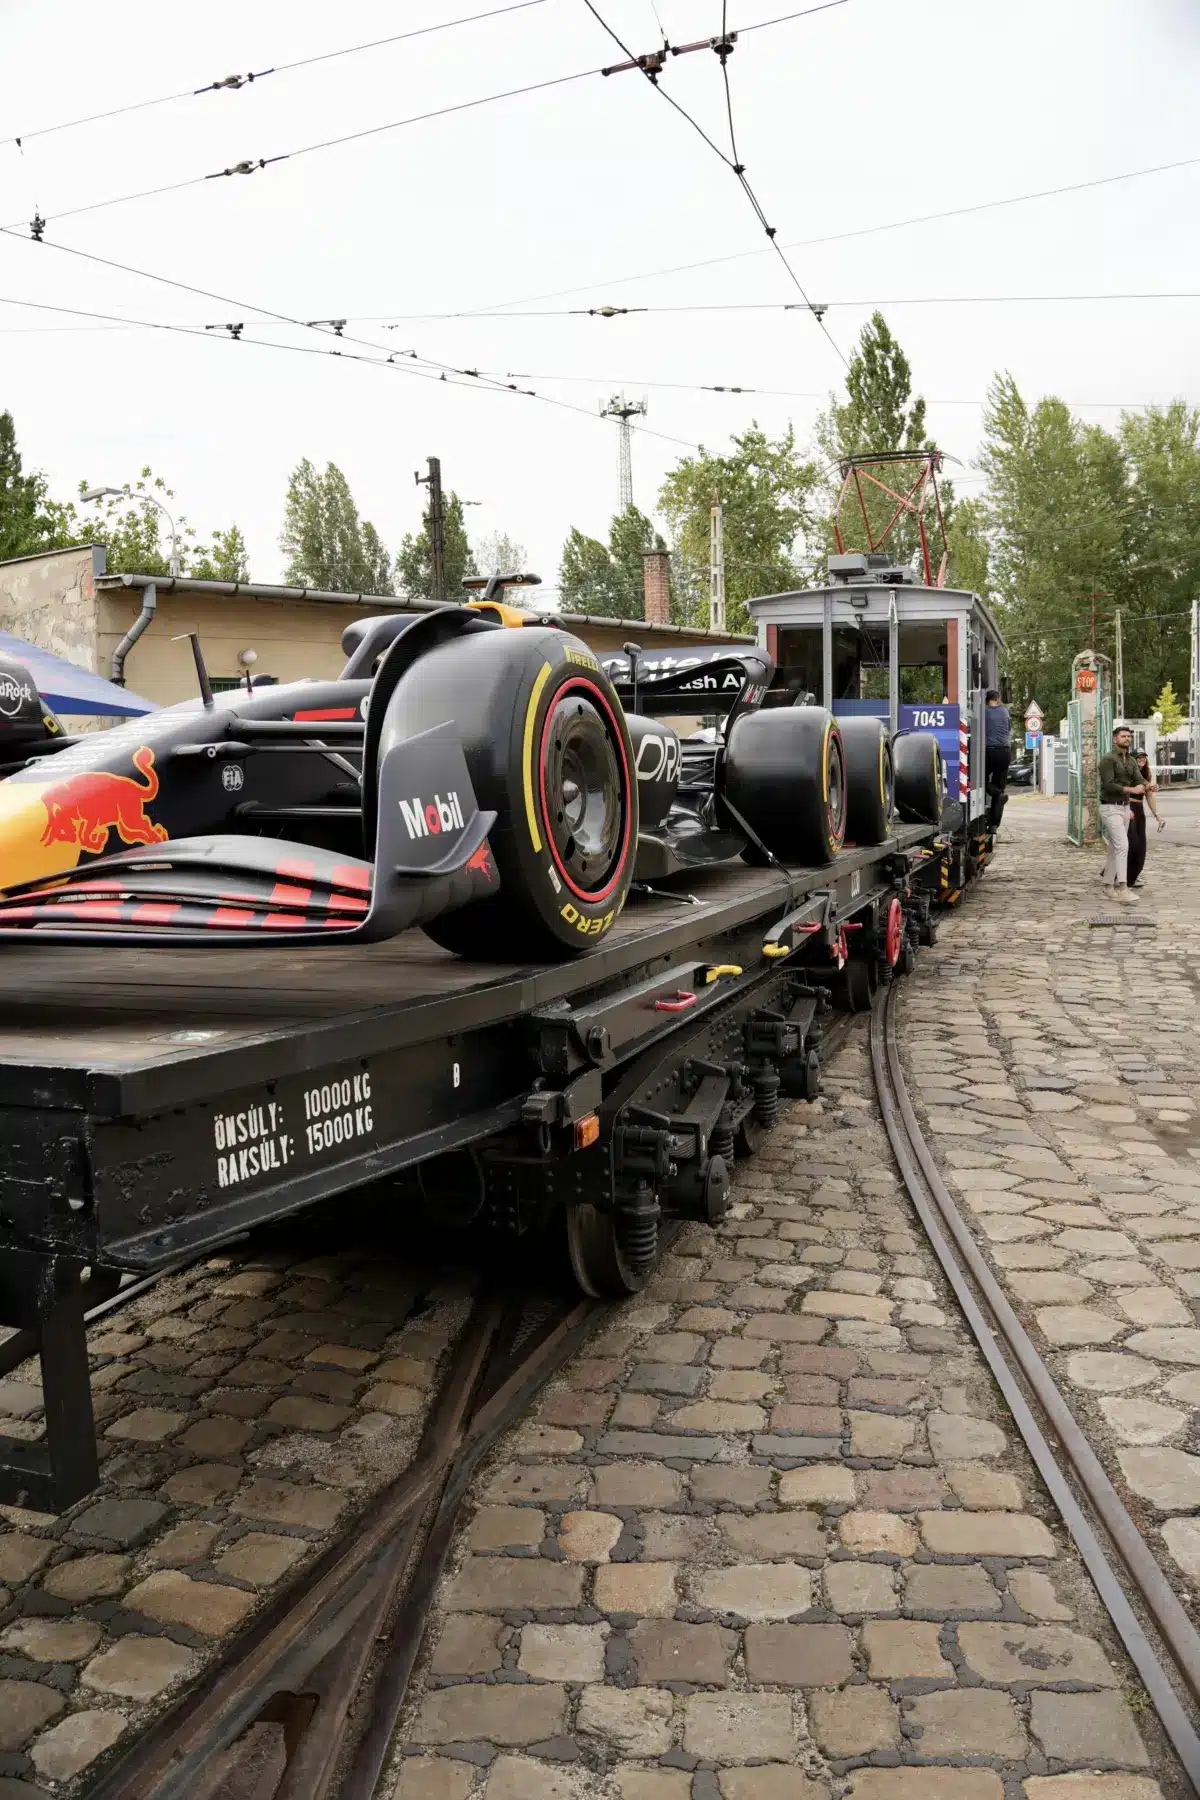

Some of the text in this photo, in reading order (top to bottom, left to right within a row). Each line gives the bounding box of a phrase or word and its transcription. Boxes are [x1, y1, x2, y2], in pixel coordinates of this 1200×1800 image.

[1077, 677, 1095, 688] STOP
[912, 710, 945, 727] 7045
[222, 768, 242, 788] FIA
[398, 791, 465, 840] Mobil
[560, 903, 615, 936] ZERO
[453, 1062, 461, 1089] B
[303, 1079, 351, 1120] 10000
[353, 1072, 371, 1103] KG
[305, 1112, 353, 1155] 15000
[355, 1105, 374, 1136] KG
